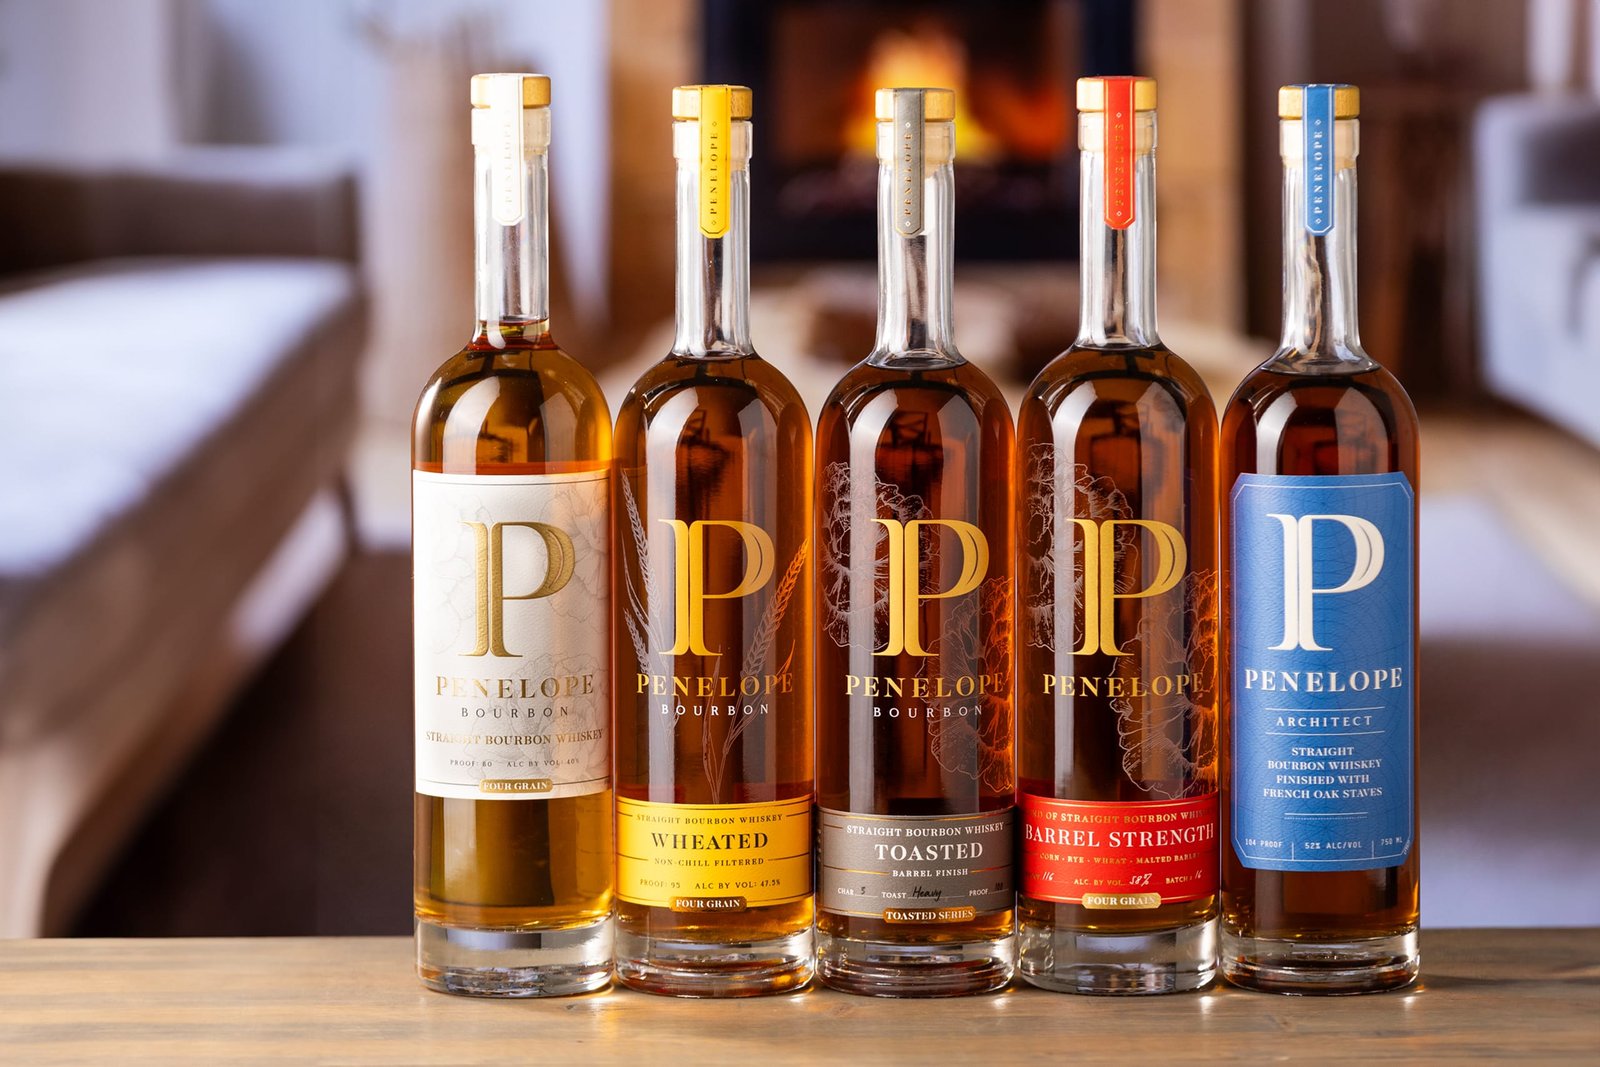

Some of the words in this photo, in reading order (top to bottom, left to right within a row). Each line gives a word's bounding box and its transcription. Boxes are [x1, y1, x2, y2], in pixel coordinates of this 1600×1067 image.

[710, 132, 718, 215] PENELOPE
[1313, 131, 1323, 214] PENELOPE
[658, 519, 775, 656] P
[870, 518, 989, 657] P
[1066, 518, 1188, 656] P
[1266, 513, 1385, 651] P
[457, 521, 575, 657] P
[636, 673, 793, 697] PENELOPE
[845, 672, 1004, 698] PENELOPE
[1042, 673, 1204, 697] PENELOPE
[1245, 667, 1403, 692] PENELOPE
[436, 674, 594, 699] PENELOPE
[461, 706, 568, 719] BOURBON
[661, 704, 769, 716] BOURBON
[873, 705, 982, 719] BOURBON
[1276, 715, 1373, 727] ARCHITECT
[425, 730, 481, 745] STRAIGHT
[485, 735, 551, 745] BOURBON
[557, 728, 604, 744] WHISKEY
[1291, 747, 1354, 757] STRAIGHT
[528, 760, 539, 768] BY
[1267, 760, 1325, 770] BOURBON
[1328, 758, 1382, 770] WHISKEY
[483, 782, 512, 791] FOUR
[514, 781, 548, 790] GRAIN
[1276, 775, 1334, 785] FINISHED
[1337, 774, 1370, 784] WITH
[1263, 788, 1310, 799] FRENCH
[1313, 790, 1339, 799] OAK
[1342, 787, 1383, 798] STAVES
[636, 813, 681, 825] STRAIGHT
[685, 817, 735, 825] BOURBON
[739, 813, 783, 823] WHISKEY
[1045, 812, 1058, 820] OF
[1060, 813, 1119, 823] STRAIGHT
[1123, 813, 1177, 824] BOURBON
[846, 824, 902, 837] STRAIGHT
[905, 827, 961, 837] BOURBON
[964, 821, 1005, 835] WHISKEY
[1025, 823, 1100, 847] BARREL
[1109, 822, 1214, 848] STRENGTH
[651, 832, 769, 850] WHEATED
[1245, 838, 1256, 847] 104
[1304, 842, 1321, 850] 52%
[1326, 841, 1363, 850] ALC/VOL
[1380, 838, 1393, 846] 750
[874, 842, 984, 861] TOASTED
[714, 857, 764, 867] FILTERED
[1039, 852, 1060, 861] CORN
[1067, 855, 1084, 864] RYE
[1093, 857, 1127, 865] WHEAT
[1136, 855, 1172, 864] MALTED
[892, 869, 932, 877] BARREL
[936, 868, 969, 877] FINISH
[1042, 871, 1055, 881] 116
[1129, 872, 1153, 887] 58%
[1165, 875, 1189, 885] BATCH
[670, 881, 681, 889] 95
[735, 881, 757, 889] VOL:
[760, 878, 781, 887] 47.5%
[837, 887, 855, 896] CHAR
[881, 891, 907, 899] TOAST
[912, 886, 942, 901] Heavy
[968, 888, 989, 897] PROOF
[675, 899, 703, 908] FOUR
[706, 899, 741, 909] GRAIN
[1088, 896, 1120, 905] FOUR
[1120, 896, 1156, 905] GRAIN
[885, 910, 937, 920] TOASTED
[938, 909, 973, 919] SERIES
